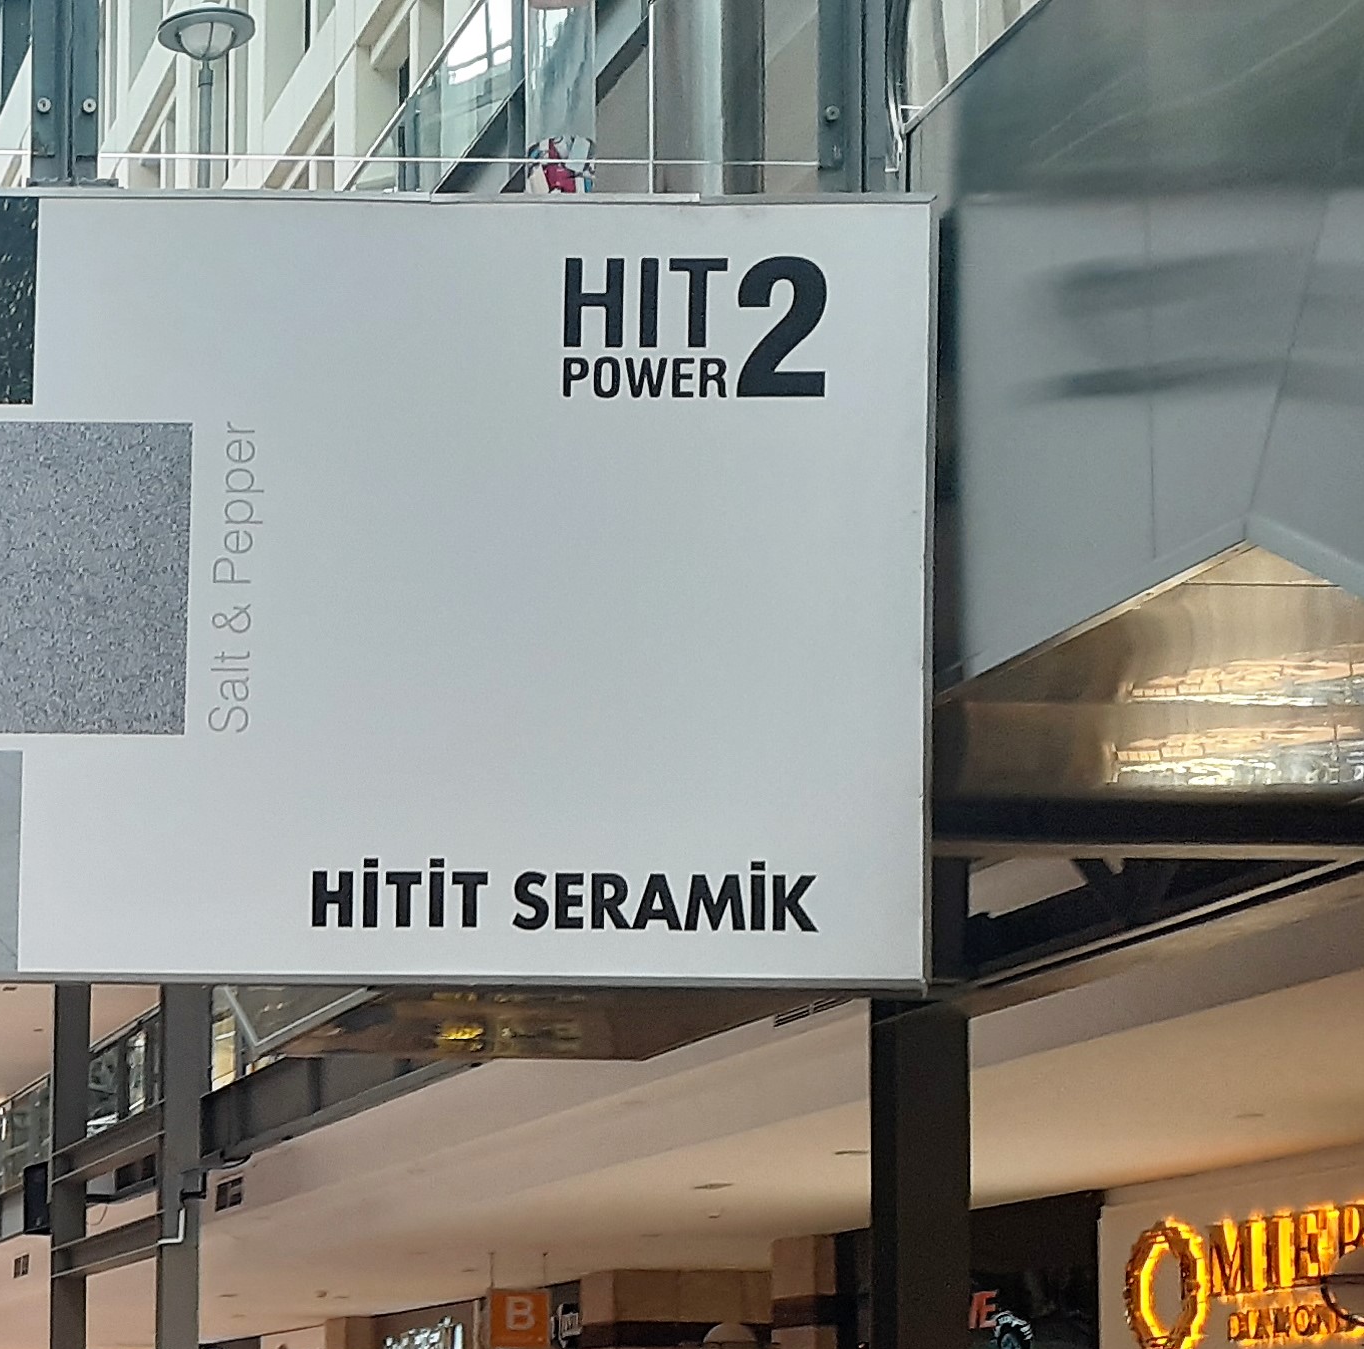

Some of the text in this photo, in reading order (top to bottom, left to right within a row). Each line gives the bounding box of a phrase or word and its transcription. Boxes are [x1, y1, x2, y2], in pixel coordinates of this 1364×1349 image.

[564, 257, 828, 399] HIT 2
[563, 357, 728, 400] POWER
[208, 420, 265, 734] Salt & Pepper
[312, 858, 819, 934] HİTİT SERAMİK
[505, 1296, 536, 1331] B
[1227, 1306, 1347, 1342] DIAMON
